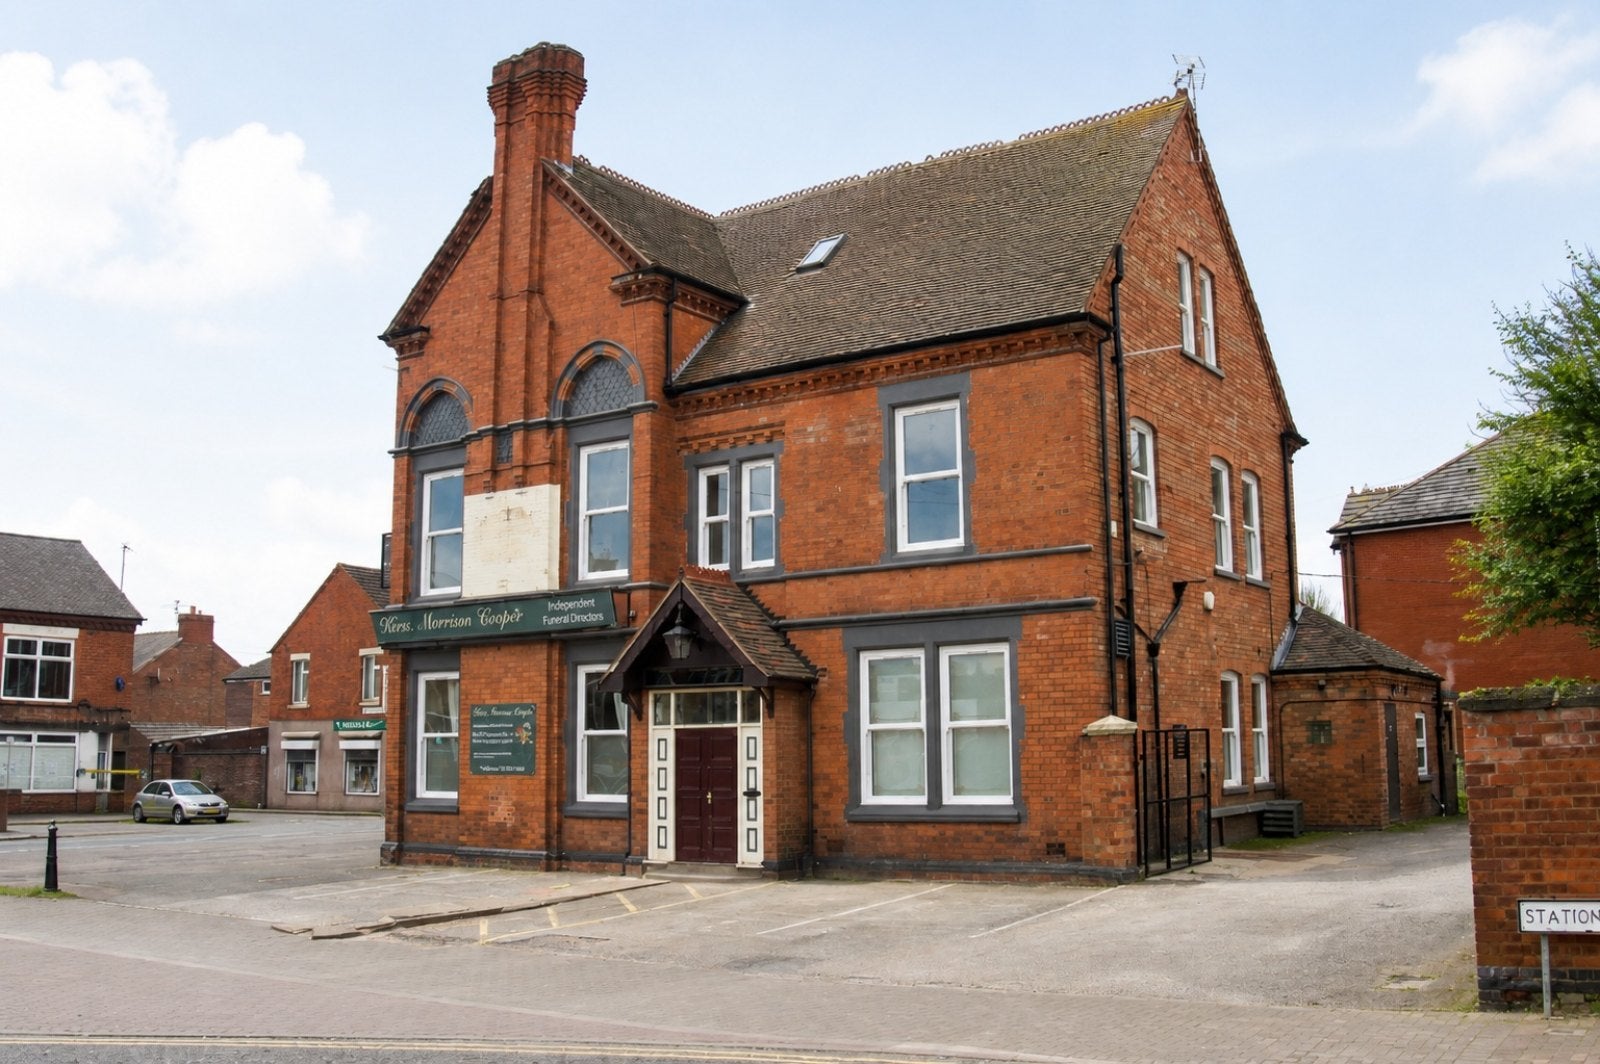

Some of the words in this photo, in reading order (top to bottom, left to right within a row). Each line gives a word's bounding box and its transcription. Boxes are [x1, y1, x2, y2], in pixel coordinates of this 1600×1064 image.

[548, 598, 595, 612] Independent
[417, 611, 471, 631] Morrison
[477, 607, 524, 630] Cooper
[542, 613, 569, 625] Funeral
[570, 612, 604, 623] Directors
[1525, 909, 1600, 924] STATION
